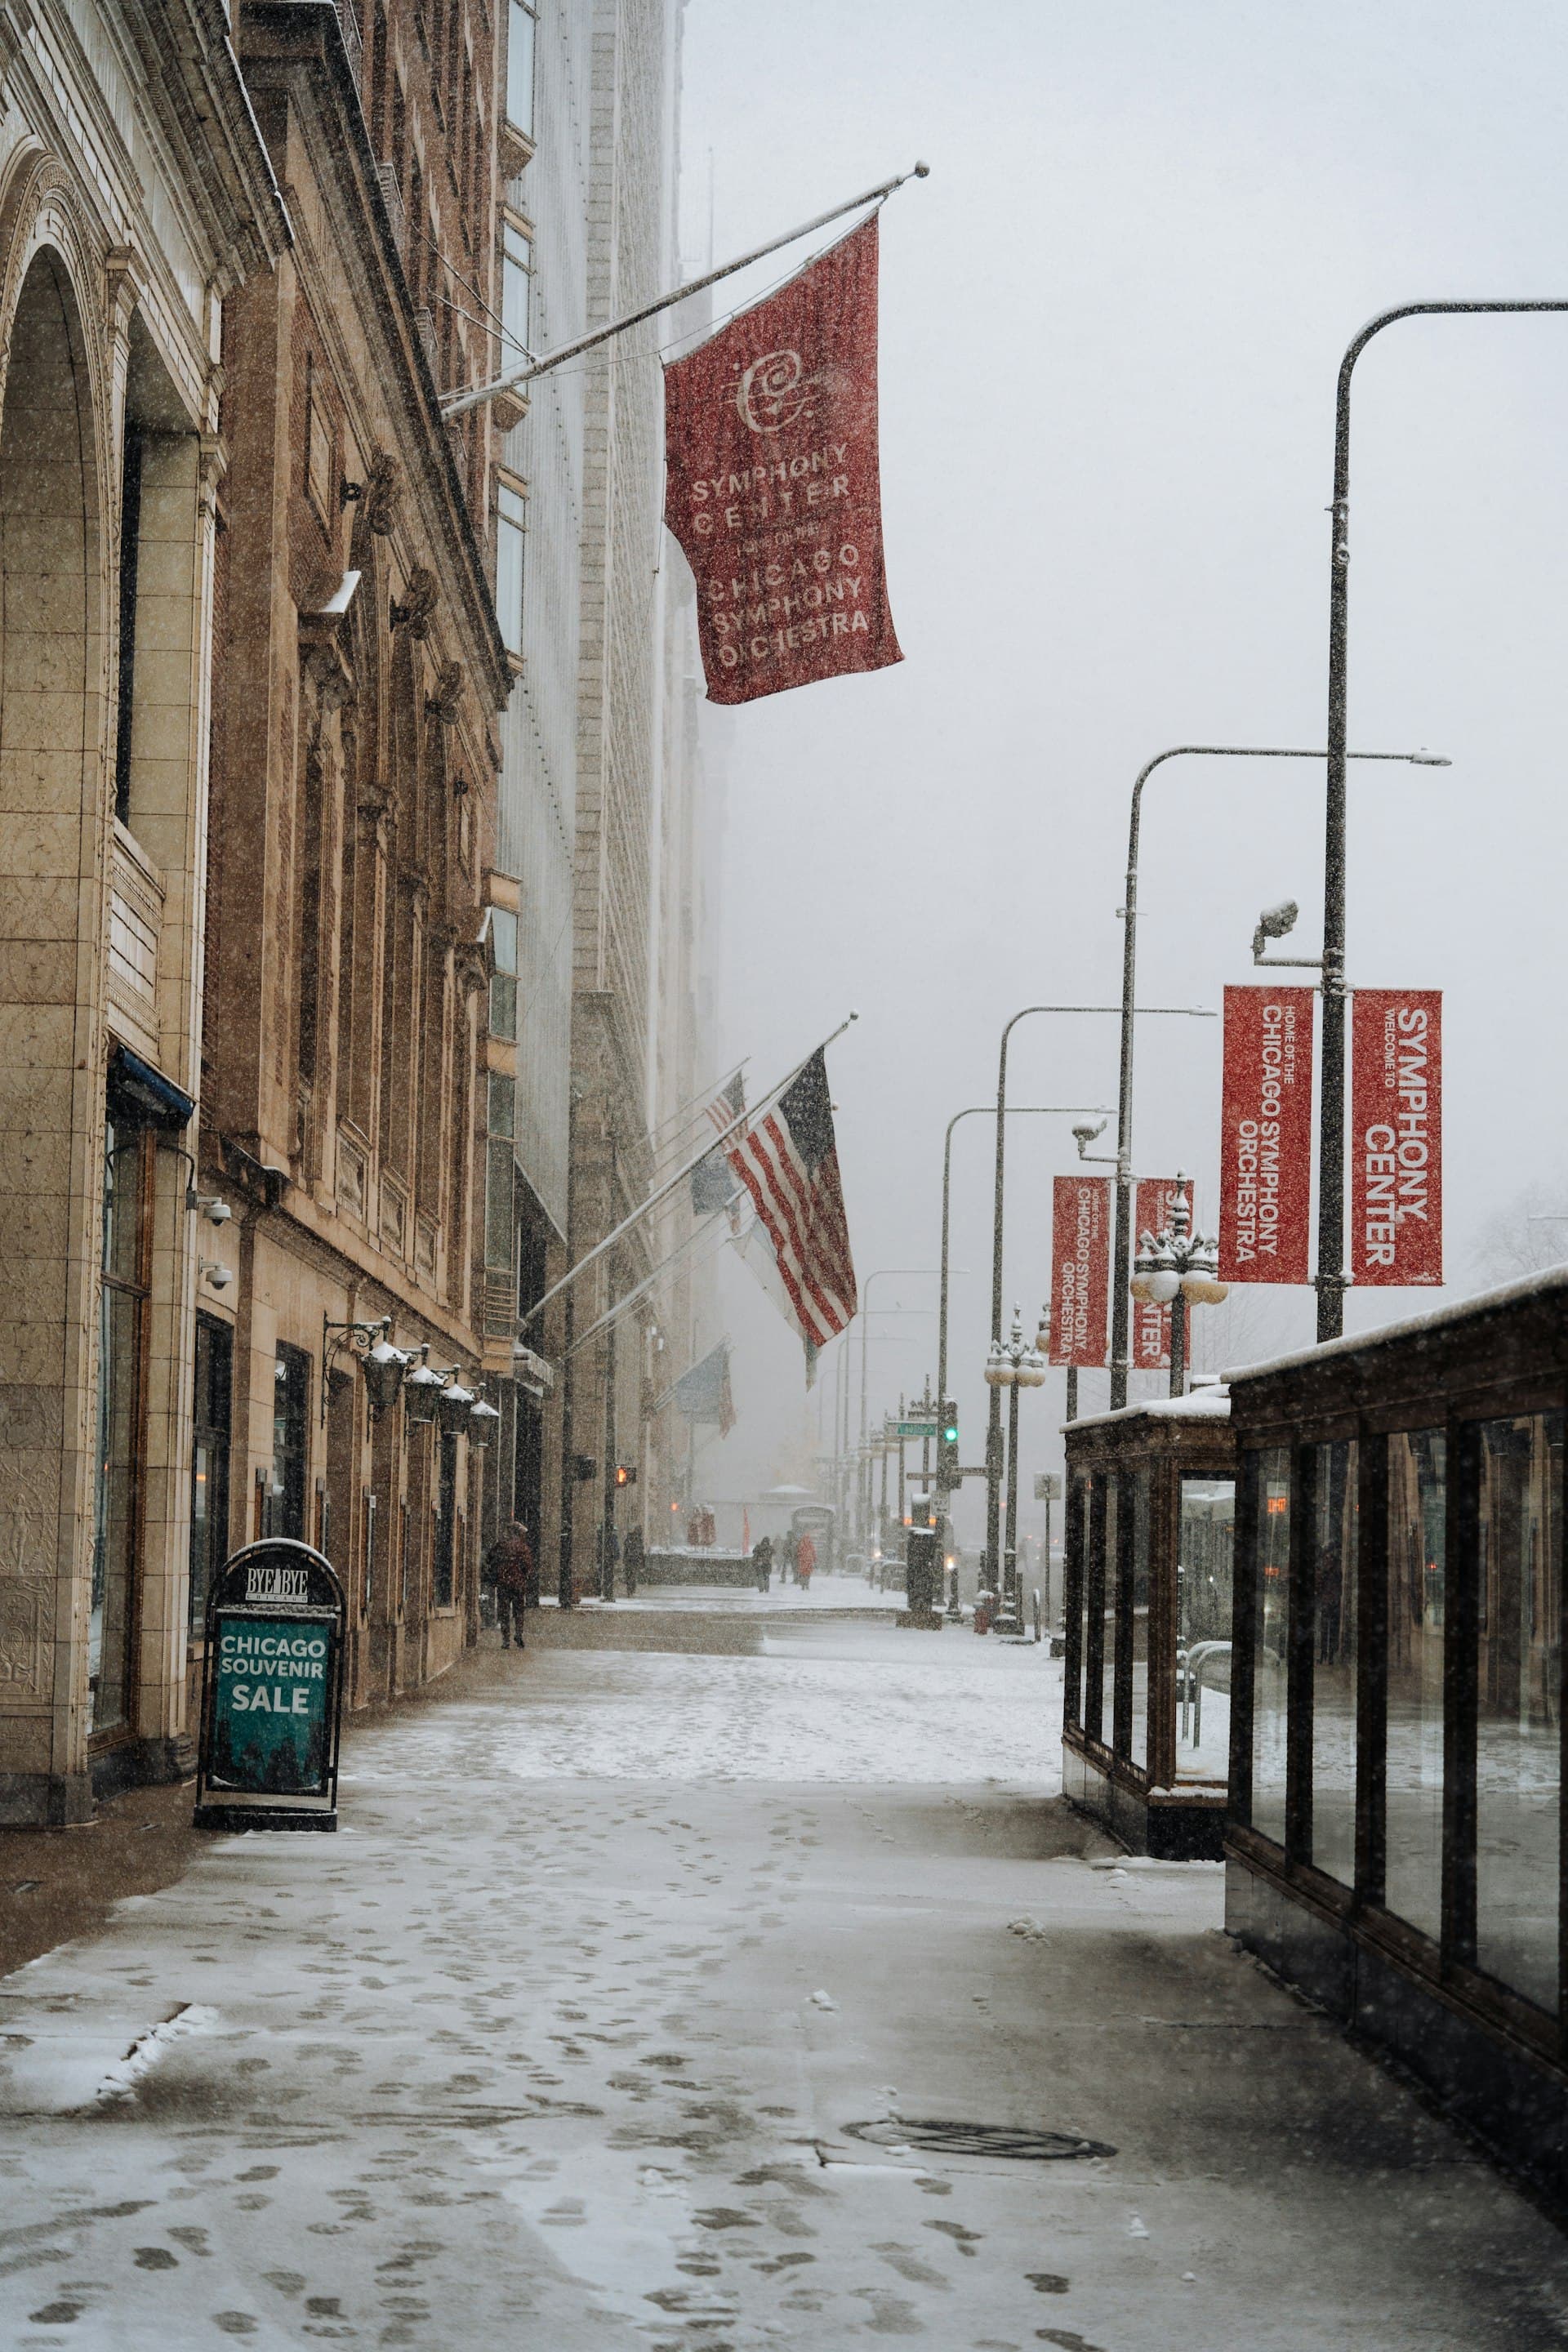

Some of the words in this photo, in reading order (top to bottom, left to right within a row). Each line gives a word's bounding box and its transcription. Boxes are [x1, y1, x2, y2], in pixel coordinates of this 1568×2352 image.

[693, 443, 848, 501] SYMPHONY
[708, 544, 858, 601] CHICAGO
[713, 576, 862, 635] SYMPHONY
[1285, 1006, 1295, 1043] HOME
[1285, 1045, 1294, 1060] OF
[1385, 1009, 1395, 1067] WELCOME
[1261, 1005, 1282, 1117] CHICAGO
[1284, 1062, 1294, 1085] THE
[1385, 1069, 1395, 1088] TO
[1397, 1008, 1428, 1221] SYMPHONY
[1236, 1120, 1258, 1263] ORCHESTRA
[1258, 1122, 1280, 1255] SYMPHONY
[1365, 1124, 1396, 1266] CENTER
[1077, 1188, 1090, 1260] CHICAGO
[1061, 1262, 1075, 1354] ORCHESTRA
[1075, 1264, 1089, 1349] SYMPHONY
[1142, 1304, 1161, 1356] NTER
[247, 1568, 274, 1593] BYE
[281, 1570, 308, 1596] BYE
[220, 1636, 326, 1659] CHICAGO
[221, 1658, 323, 1680] SOUVENIR
[232, 1685, 310, 1714] SALE
